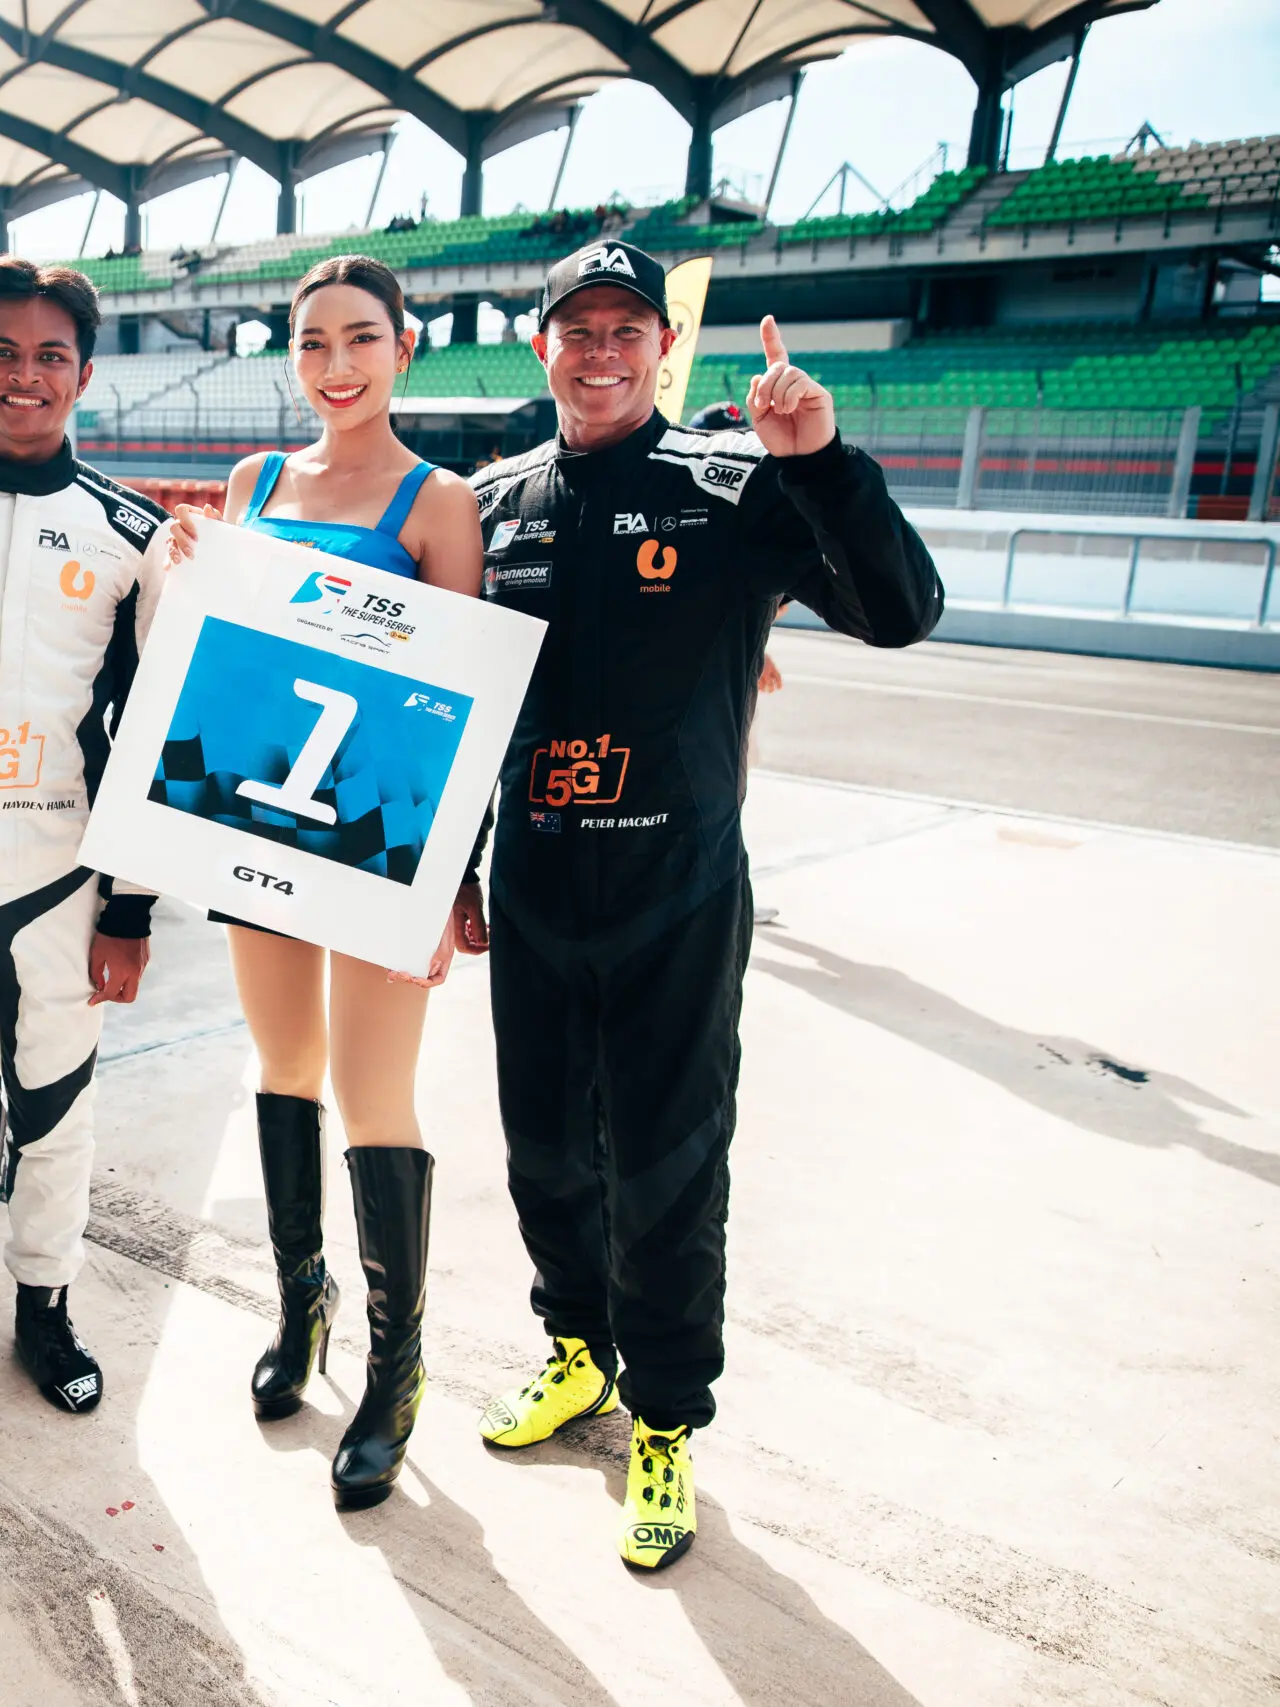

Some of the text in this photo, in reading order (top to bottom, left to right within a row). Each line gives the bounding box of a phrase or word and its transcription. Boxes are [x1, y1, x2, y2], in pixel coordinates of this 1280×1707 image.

[704, 466, 743, 487] OMP
[116, 508, 152, 534] OMP
[524, 519, 549, 533] TSS
[523, 533, 538, 541] SUPER
[538, 531, 556, 539] SERIES
[640, 583, 671, 593] mobile
[362, 593, 406, 618] TSS
[297, 617, 327, 632] ORGANIZED
[341, 605, 417, 635] THE SUPER SERIES
[433, 701, 453, 713] TSS
[235, 677, 359, 826] 1
[549, 734, 612, 759] NO.1
[545, 760, 600, 807] 5G
[2, 799, 76, 811] HAYDEN HAIKAL
[580, 812, 670, 829] PETER HACKETT
[232, 865, 295, 896] GT4
[633, 1527, 687, 1546] OMP
